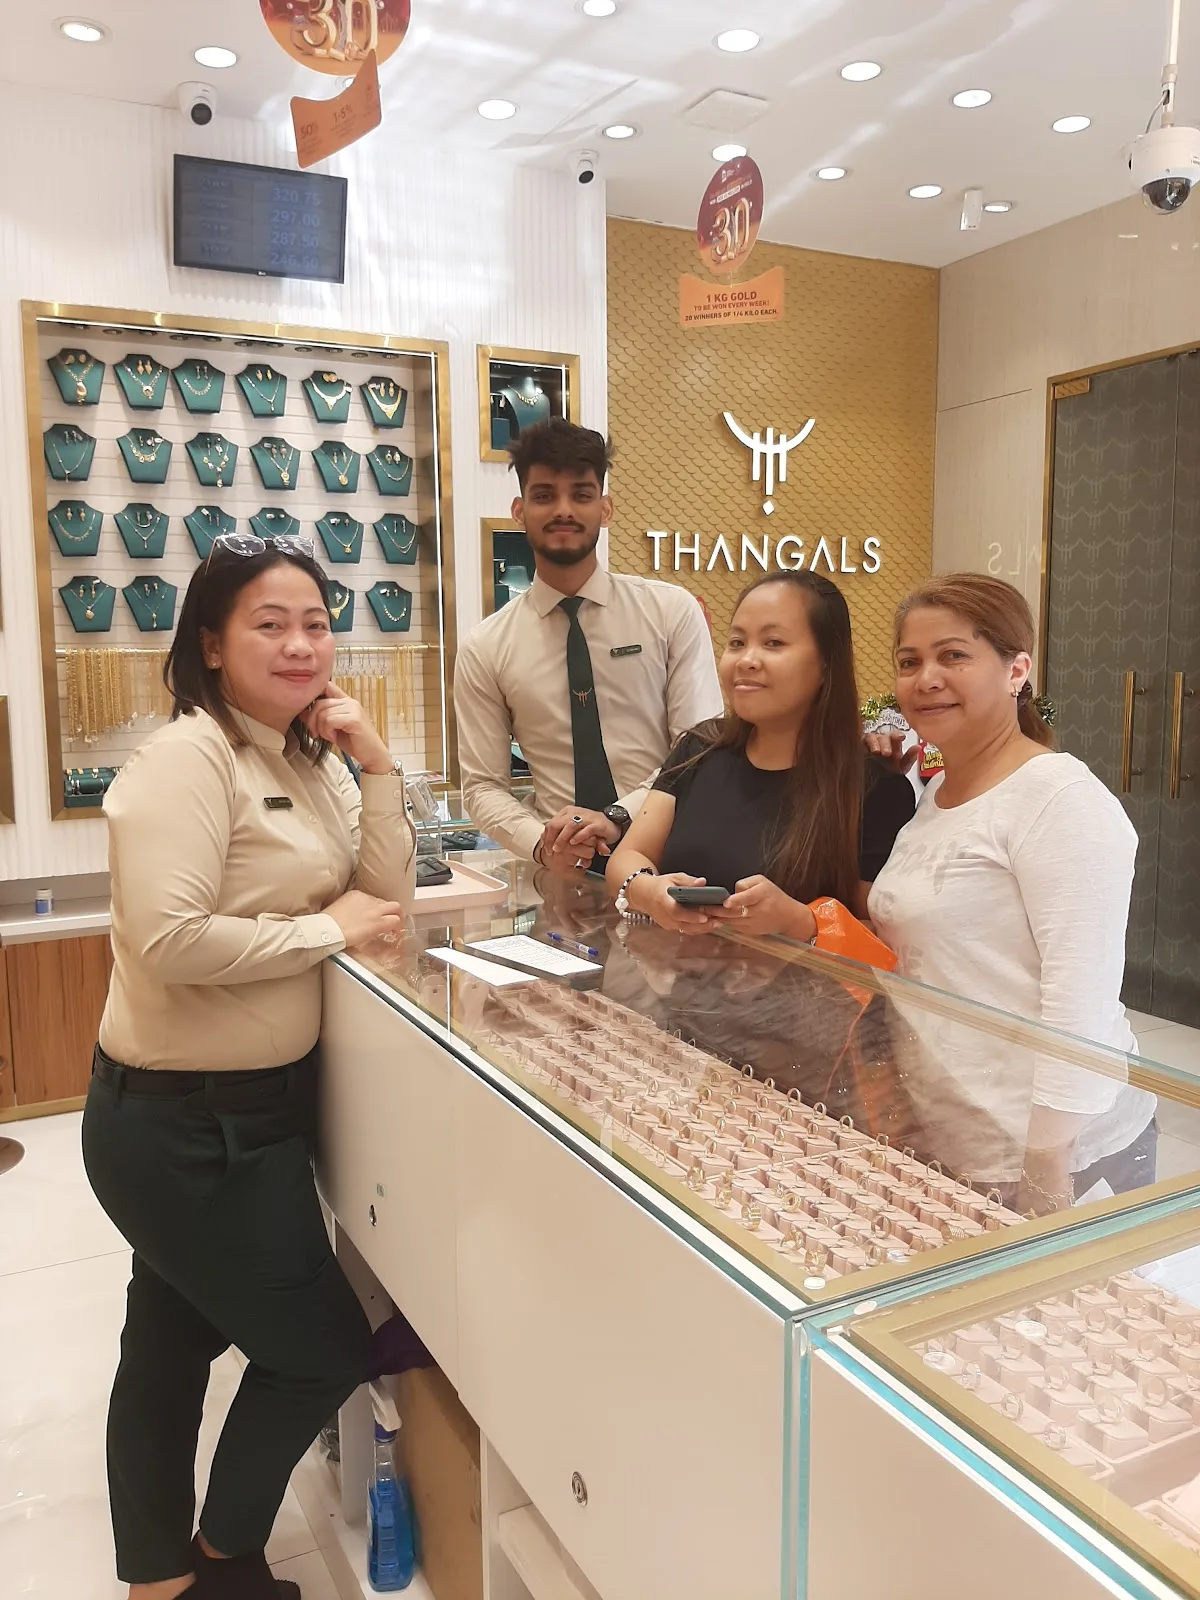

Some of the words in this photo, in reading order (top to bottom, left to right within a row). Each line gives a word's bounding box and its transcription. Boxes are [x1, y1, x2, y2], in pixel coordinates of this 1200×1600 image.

[706, 294, 711, 303] 1
[714, 293, 728, 303] KG
[730, 291, 757, 301] GOLD
[728, 301, 748, 309] EVERY
[693, 312, 722, 320] WINNERS
[733, 310, 743, 318] 1/4
[646, 530, 882, 574] THANGALS
